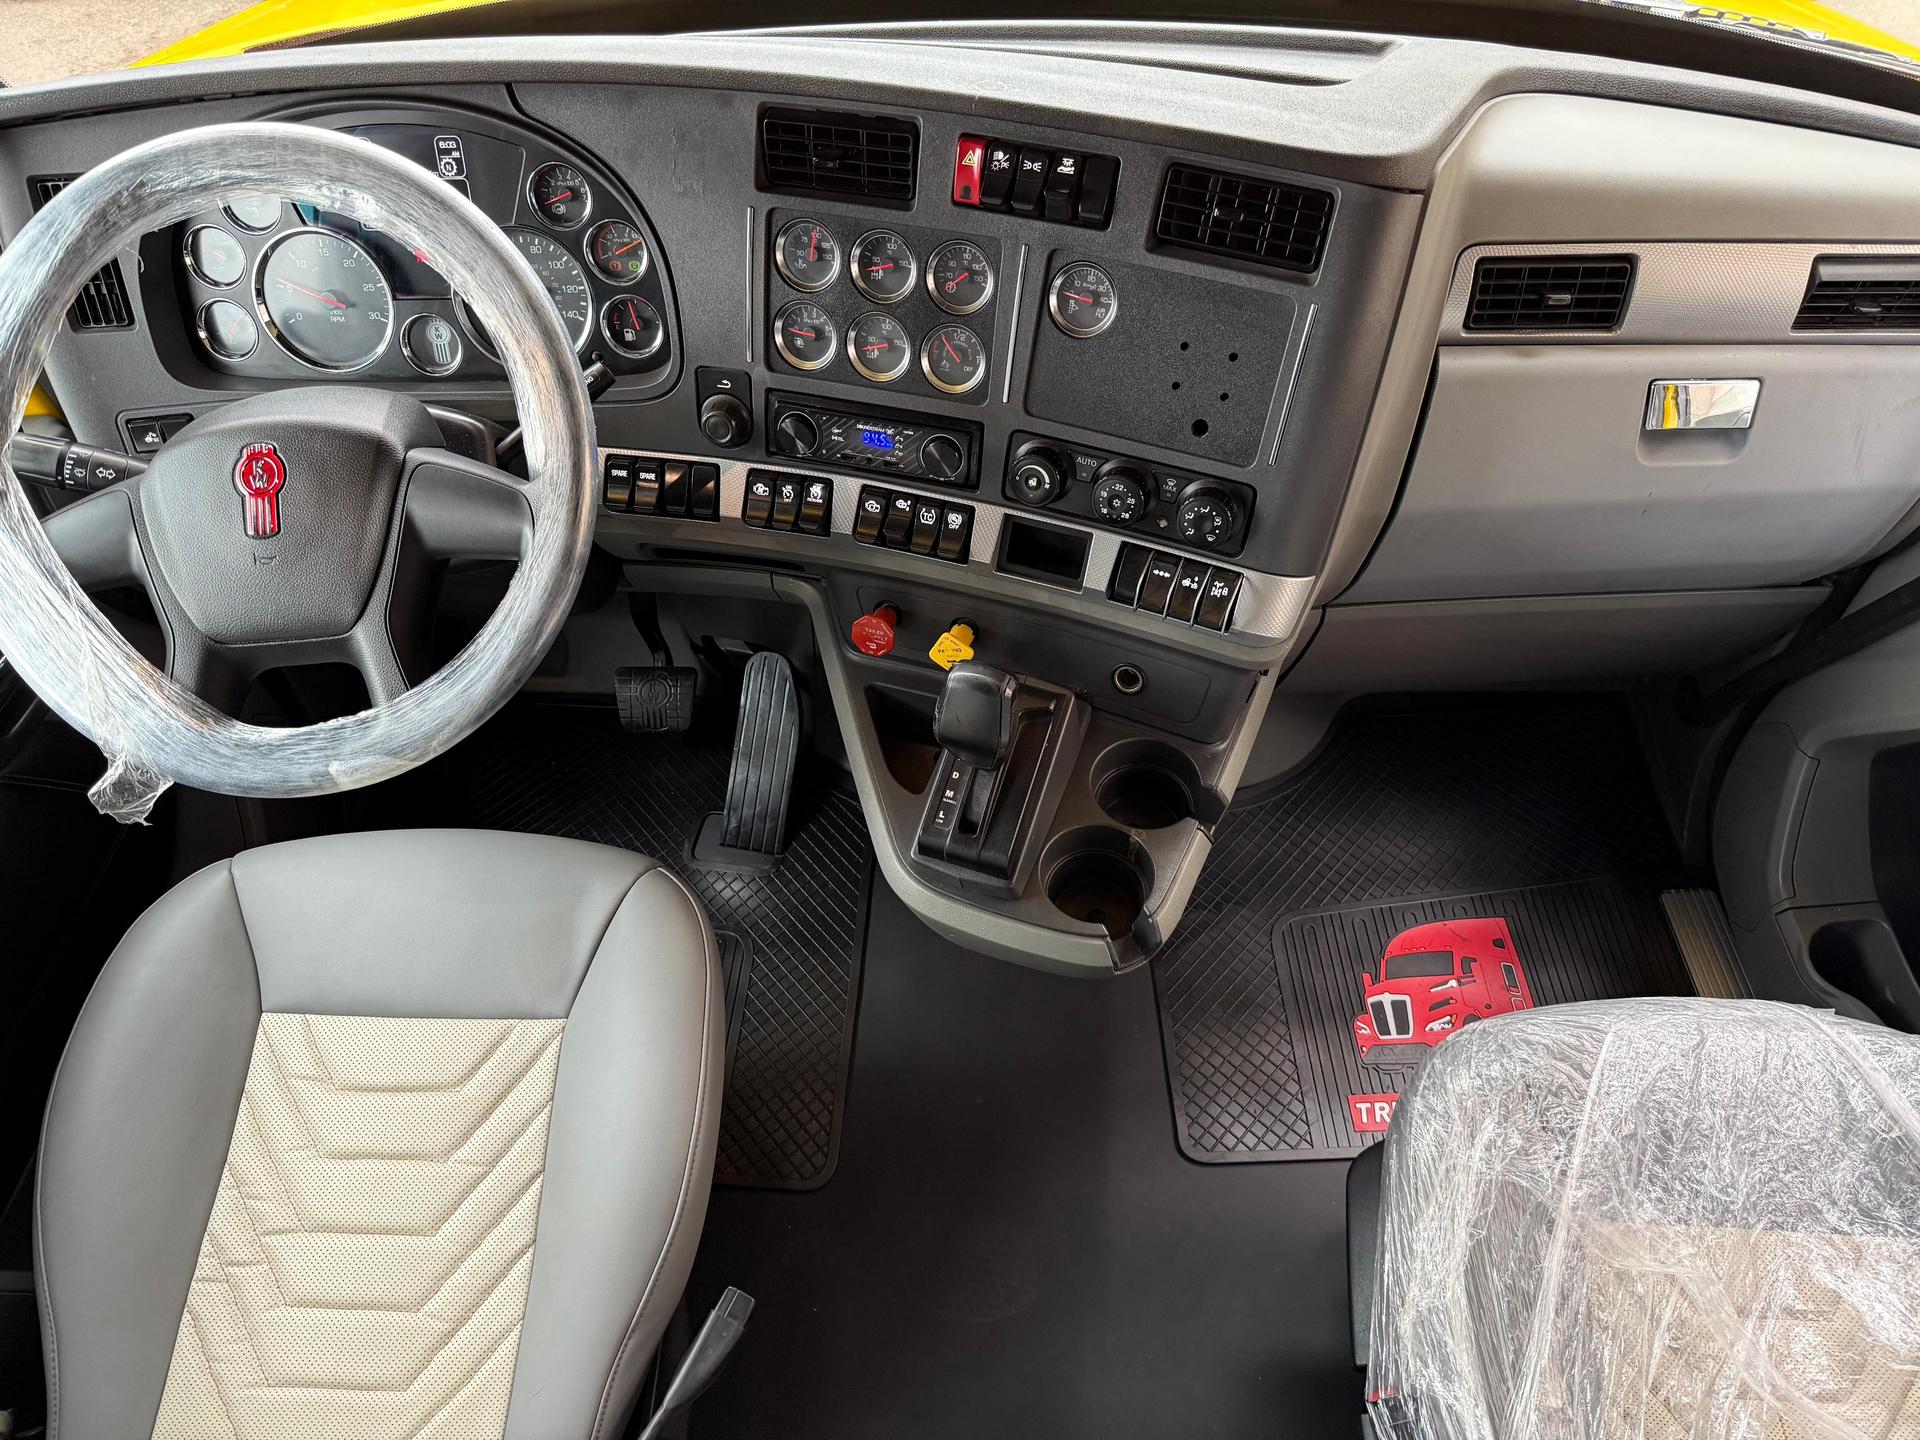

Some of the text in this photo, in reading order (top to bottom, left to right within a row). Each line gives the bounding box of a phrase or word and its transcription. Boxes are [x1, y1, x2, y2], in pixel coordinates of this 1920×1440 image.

[446, 163, 452, 171] N
[319, 248, 330, 257] 15
[530, 246, 542, 254] 80
[296, 259, 308, 268] 10
[343, 259, 356, 268] 20
[362, 283, 375, 292] 25
[368, 312, 382, 320] 30
[954, 333, 965, 342] 1/2
[1076, 456, 1097, 467] AUTO
[252, 460, 264, 475] K
[612, 469, 628, 478] SPARE
[640, 472, 656, 481] SPARE
[249, 473, 268, 490] W
[1162, 484, 1178, 493] MAX
[923, 512, 933, 521] TC
[945, 790, 954, 798] M
[1356, 1102, 1396, 1124] TR
